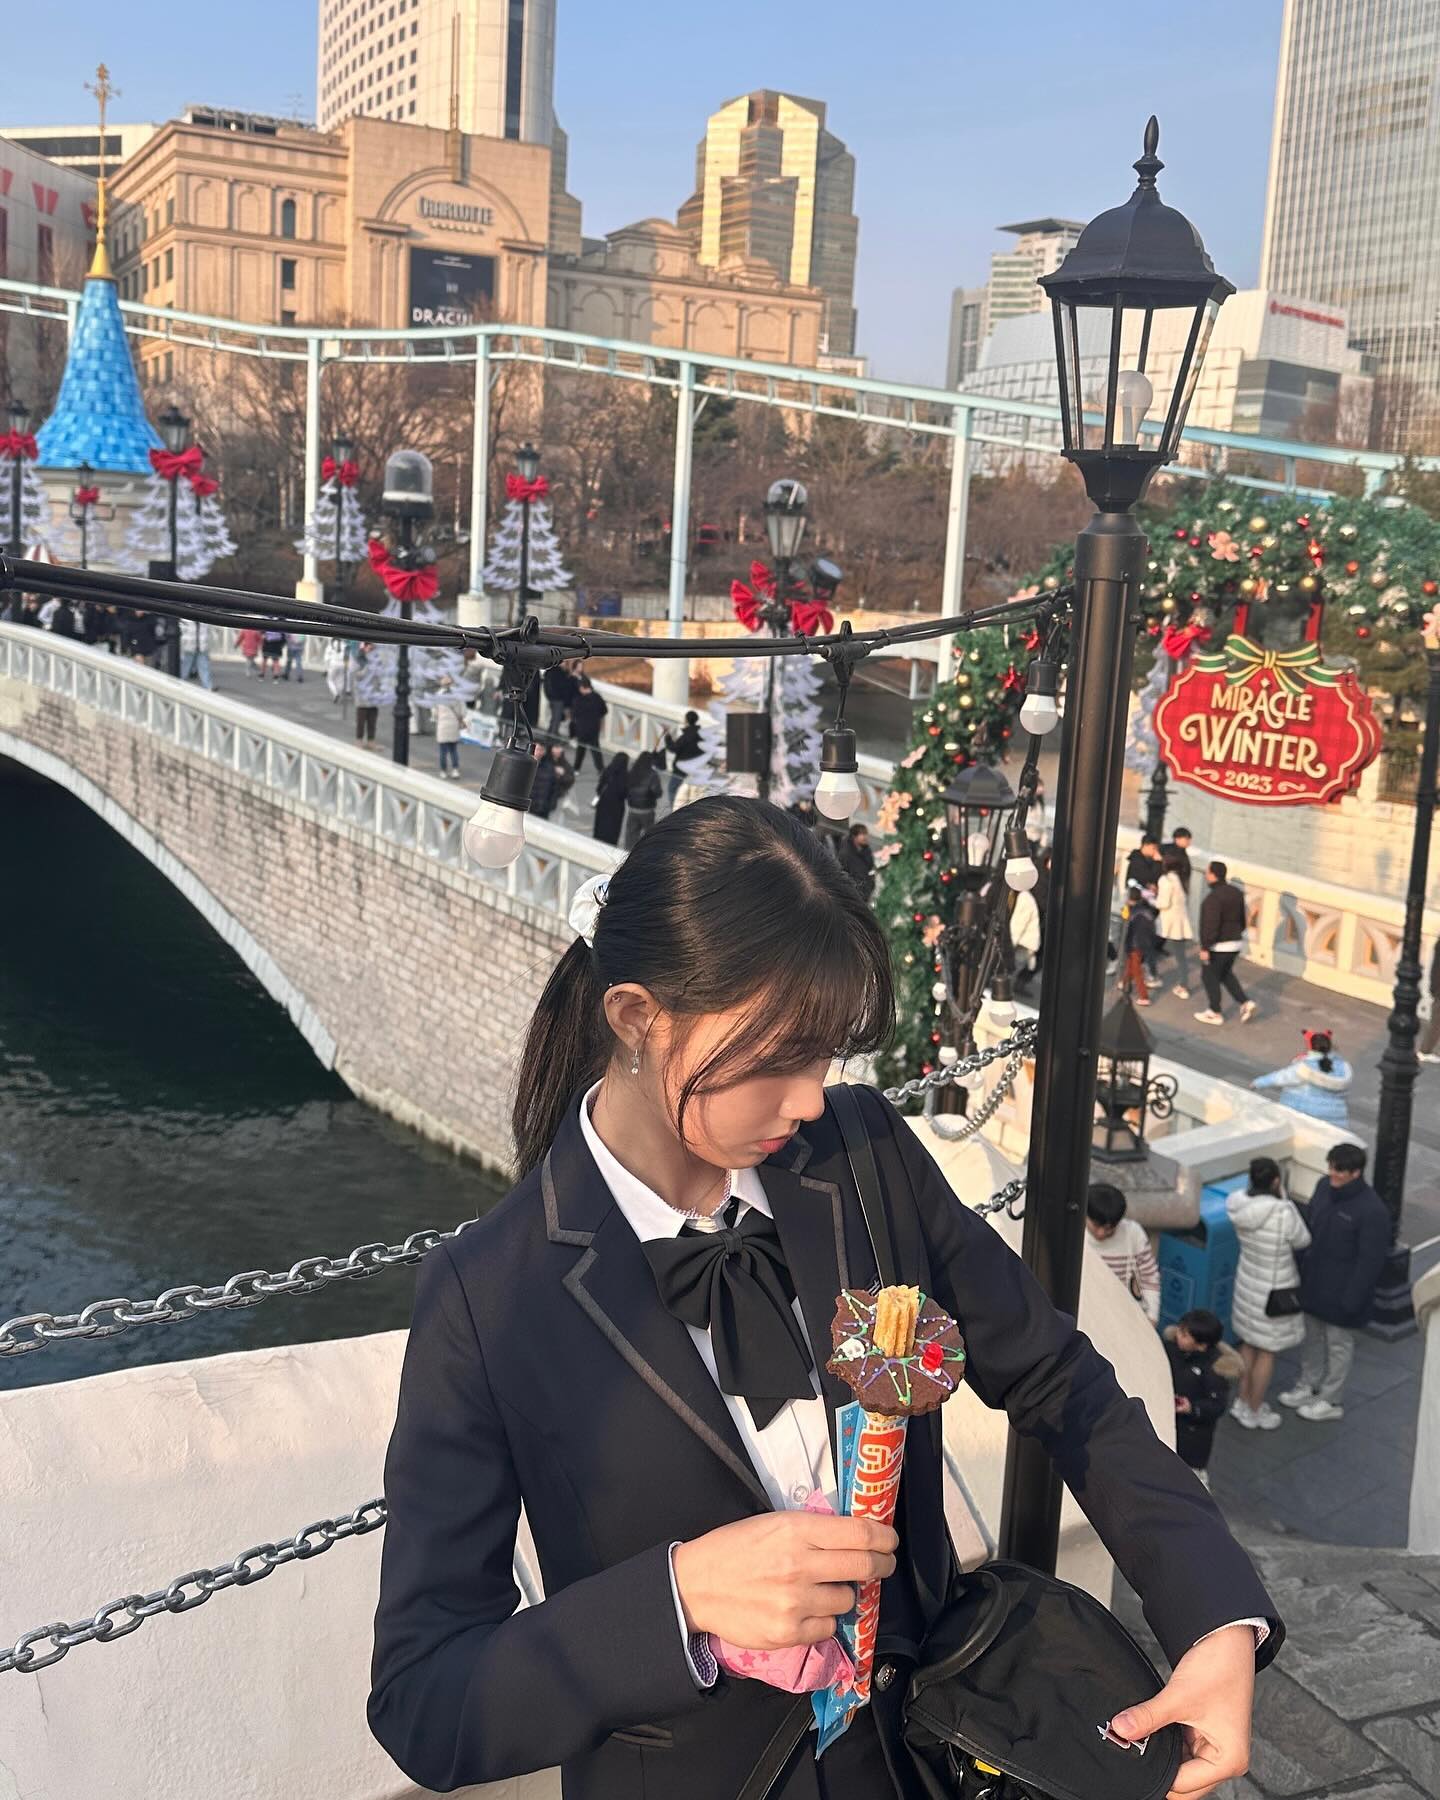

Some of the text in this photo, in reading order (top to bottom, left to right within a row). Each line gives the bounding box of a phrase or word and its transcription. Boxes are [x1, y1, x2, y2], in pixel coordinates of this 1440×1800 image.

[1211, 683, 1313, 729] MIRACLE
[1179, 710, 1327, 778] WINTER
[1224, 770, 1273, 793] 2023
[851, 1428, 907, 1526] GYR
